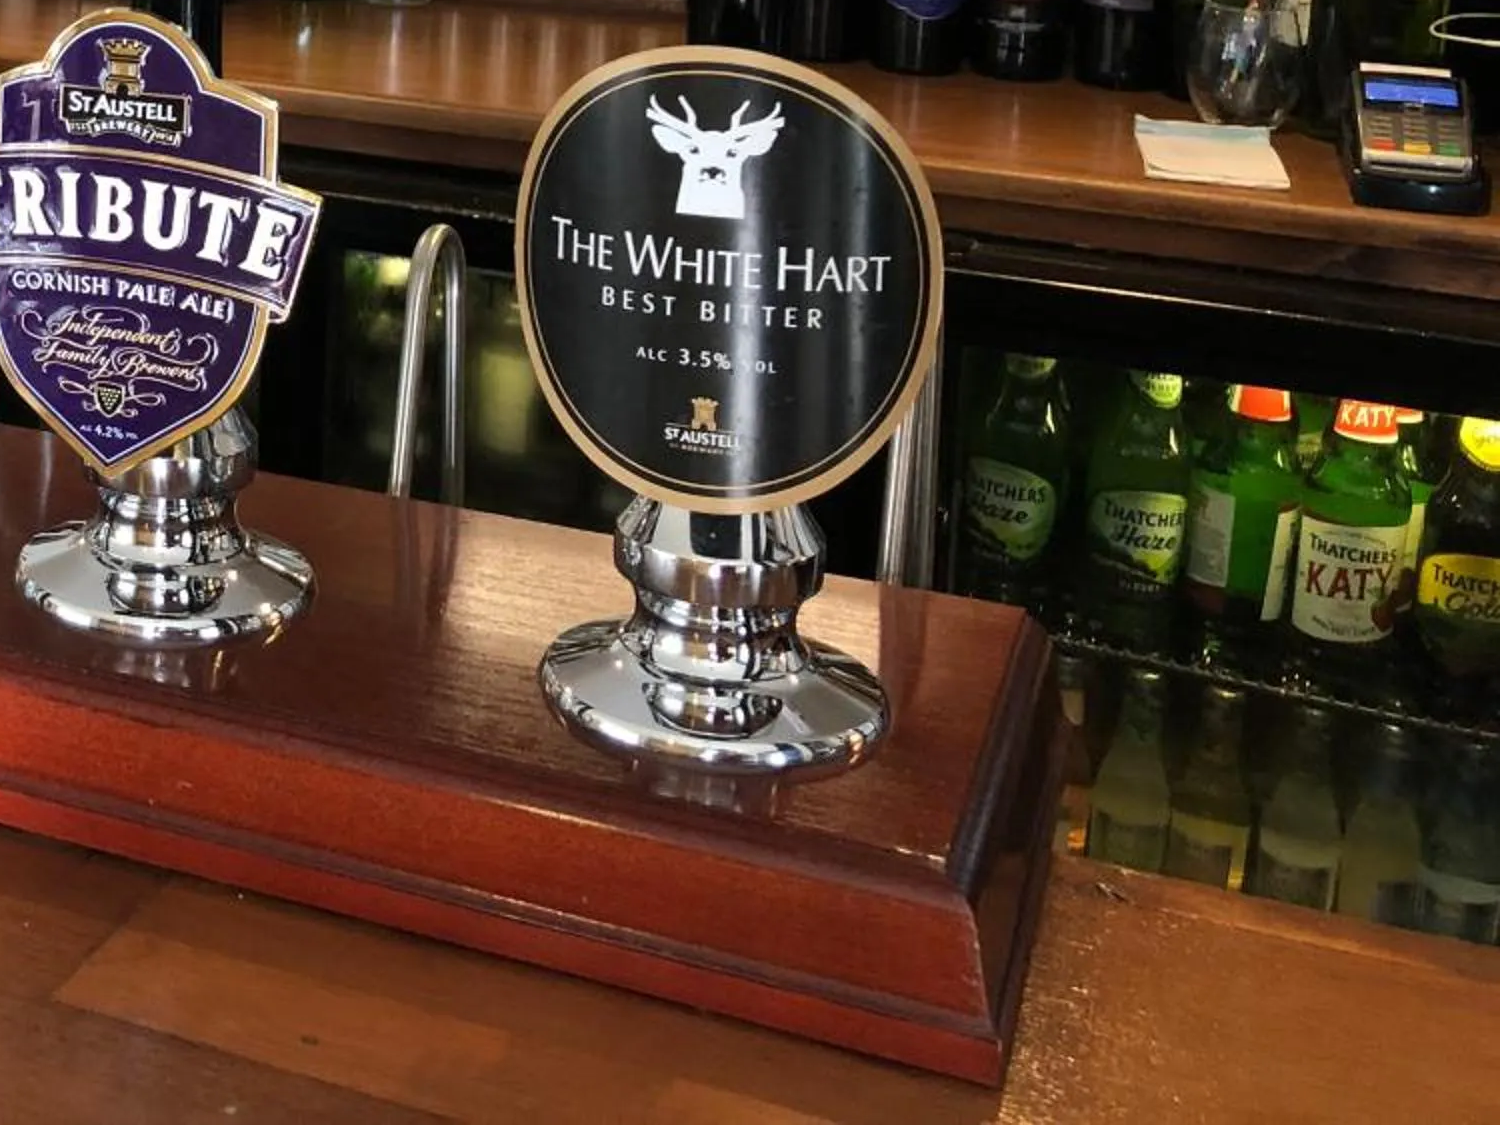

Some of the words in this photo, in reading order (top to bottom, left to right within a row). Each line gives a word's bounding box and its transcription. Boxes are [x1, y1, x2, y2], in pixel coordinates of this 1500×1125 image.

[93, 94, 177, 122] AUSTELL
[551, 215, 615, 271] THE
[624, 230, 763, 290] WHITE
[777, 246, 892, 292] HART
[12, 270, 111, 296] CORNISH
[116, 278, 176, 307] PALE
[179, 291, 235, 323] ALE
[601, 285, 677, 316] BEST
[699, 300, 824, 329] BITTER
[40, 306, 181, 355] Independent
[32, 339, 114, 379] Family
[636, 346, 668, 362] ALC
[678, 348, 732, 370] 3.5%
[94, 424, 124, 440] 4.2%
[1340, 404, 1396, 428] KATY
[680, 430, 741, 449] AUSTELL
[1114, 524, 1177, 551] Haze
[1311, 534, 1398, 566] THATCHERS
[1306, 561, 1393, 601] KATY
